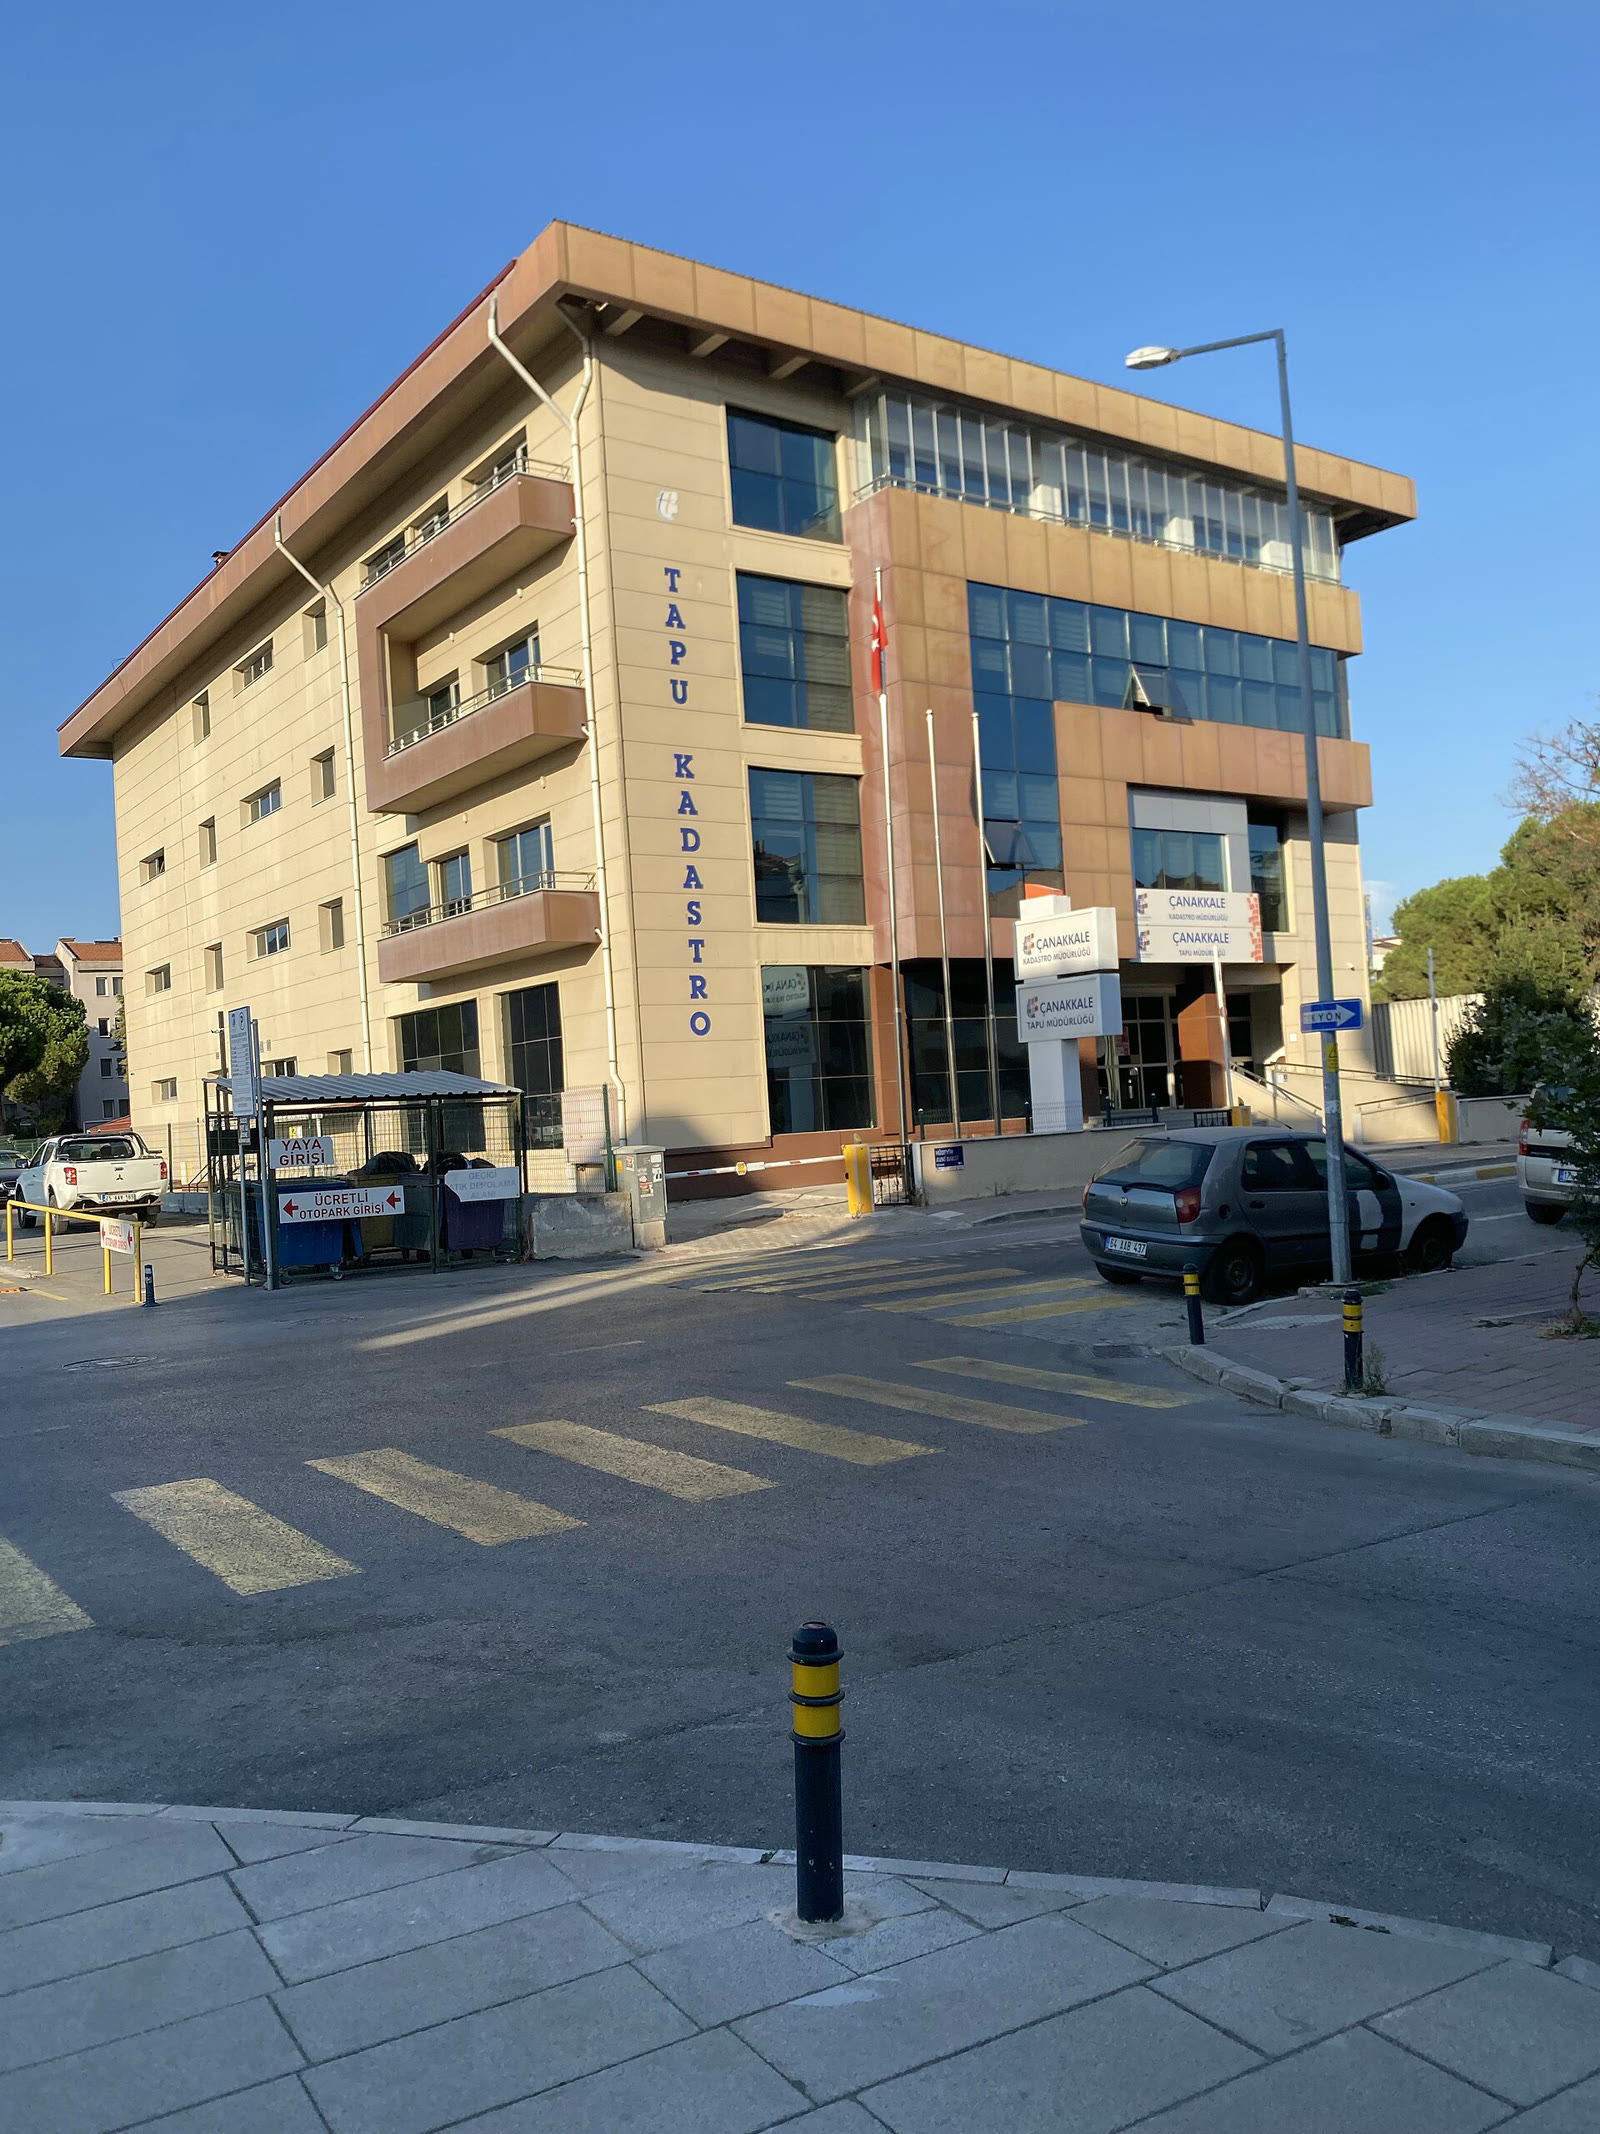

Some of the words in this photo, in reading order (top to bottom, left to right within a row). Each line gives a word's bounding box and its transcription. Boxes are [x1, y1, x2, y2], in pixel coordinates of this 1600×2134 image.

[664, 567, 688, 705] TAPU
[674, 753, 711, 1036] KADASTRO
[1169, 895, 1226, 910] ÇANAKKALE
[1168, 913, 1195, 921] KADASTRO
[1036, 931, 1090, 953] ÇANAKKALE
[1172, 932, 1229, 946] ÇANAKKALE
[1022, 954, 1052, 965] KADASTRO
[1053, 947, 1091, 960] MÜDÜRLÜĞÜ
[1040, 997, 1094, 1017] ÇANAKKALE
[1027, 1021, 1045, 1030] TAPU
[1046, 1013, 1094, 1028] MÜDÜRLÜĞÜ
[281, 1138, 322, 1152] YAYA
[279, 1149, 325, 1166] GİRİŞİ
[314, 1189, 368, 1206] ÜCRETLİ
[299, 1206, 351, 1219] OTOPARK
[353, 1201, 385, 1215] GİRİŞİ
